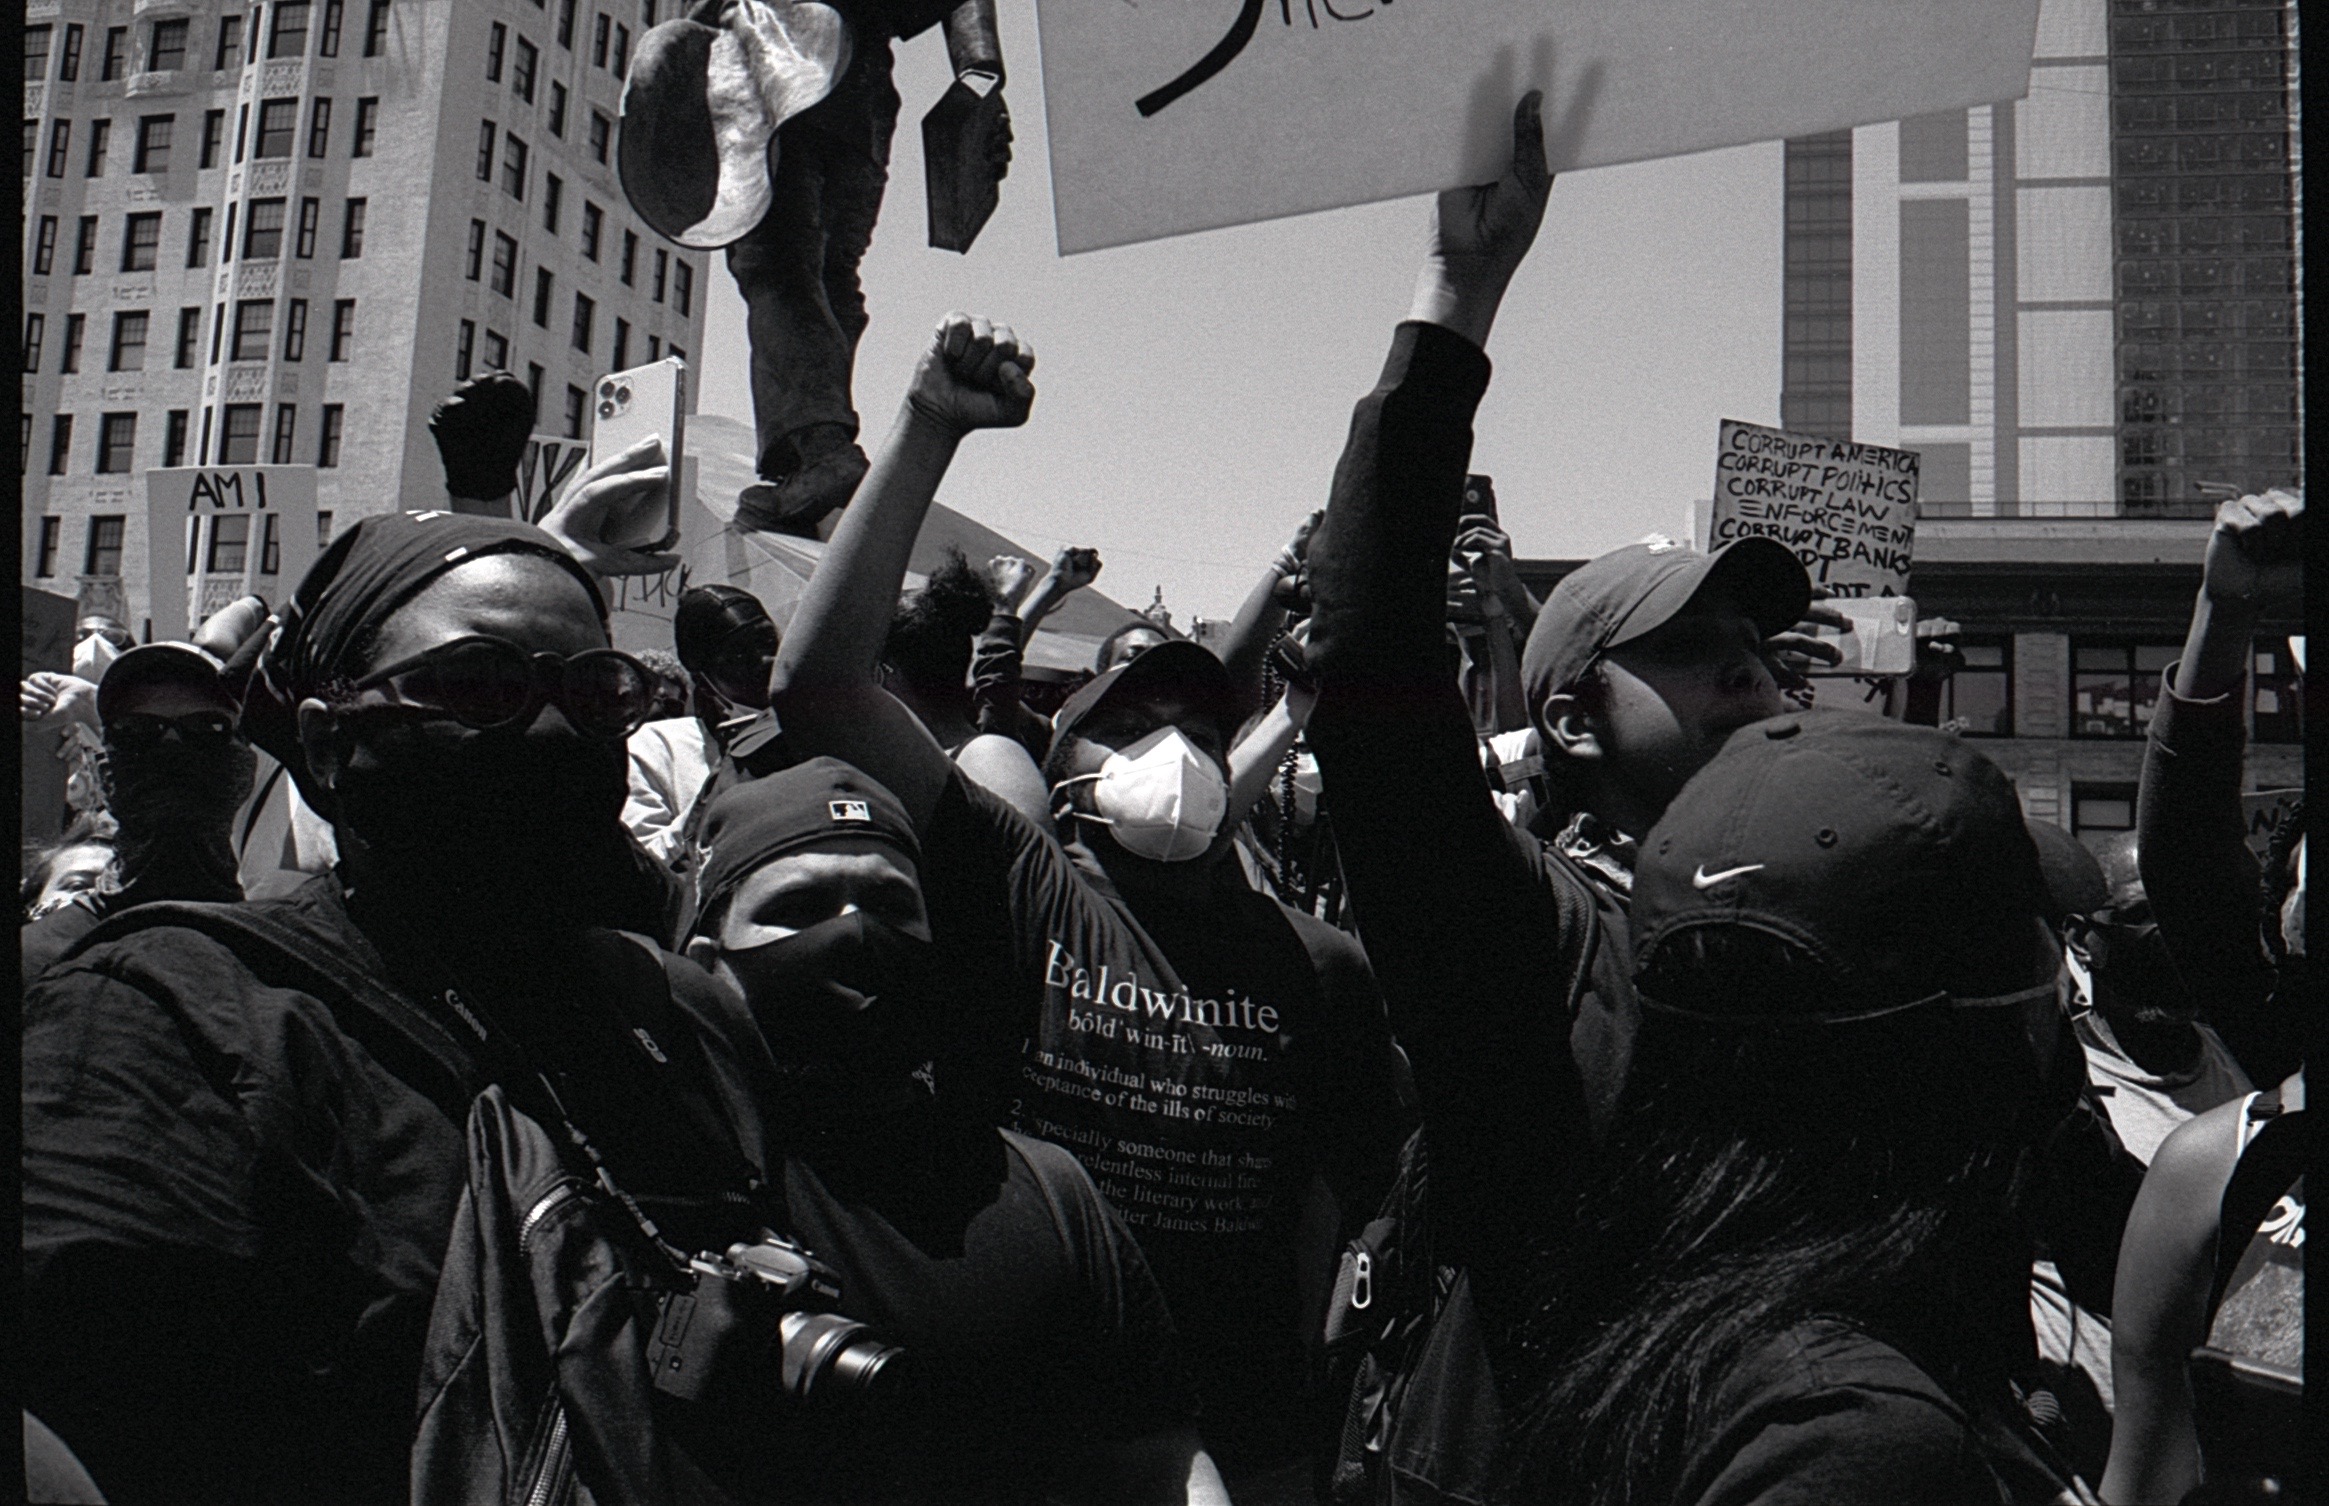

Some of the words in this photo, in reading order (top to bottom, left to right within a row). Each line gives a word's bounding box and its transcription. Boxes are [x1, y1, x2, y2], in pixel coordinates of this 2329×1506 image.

[1718, 451, 1820, 483] CORRUPT
[1731, 429, 1826, 460] CORRUPT
[189, 472, 245, 511] AM
[1727, 477, 1823, 504] CORRUPT
[1825, 491, 1890, 522] LAW
[1739, 499, 1915, 548] ENFORCEMENT
[1718, 517, 1832, 550] CORRUPT
[1833, 536, 1912, 577] BANKS
[1044, 938, 1280, 1034] Baldwinite
[444, 988, 488, 1042] Canon
[1034, 1050, 1054, 1067] an
[1056, 1052, 1146, 1090] individual
[1149, 1077, 1188, 1097] who
[1191, 1084, 1270, 1107] struggles
[1104, 1091, 1126, 1107] of
[1129, 1094, 1158, 1113] the
[1162, 1098, 1190, 1119] ills
[1194, 1104, 1217, 1122] of
[1218, 1106, 1277, 1129] society
[1035, 1118, 1112, 1152] specially
[1116, 1138, 1196, 1165] someone
[1201, 1148, 1232, 1168] that
[1099, 1177, 1127, 1198] the
[1133, 1184, 1198, 1213] literary
[1117, 1203, 1149, 1225] iter
[1153, 1211, 1207, 1232] James
